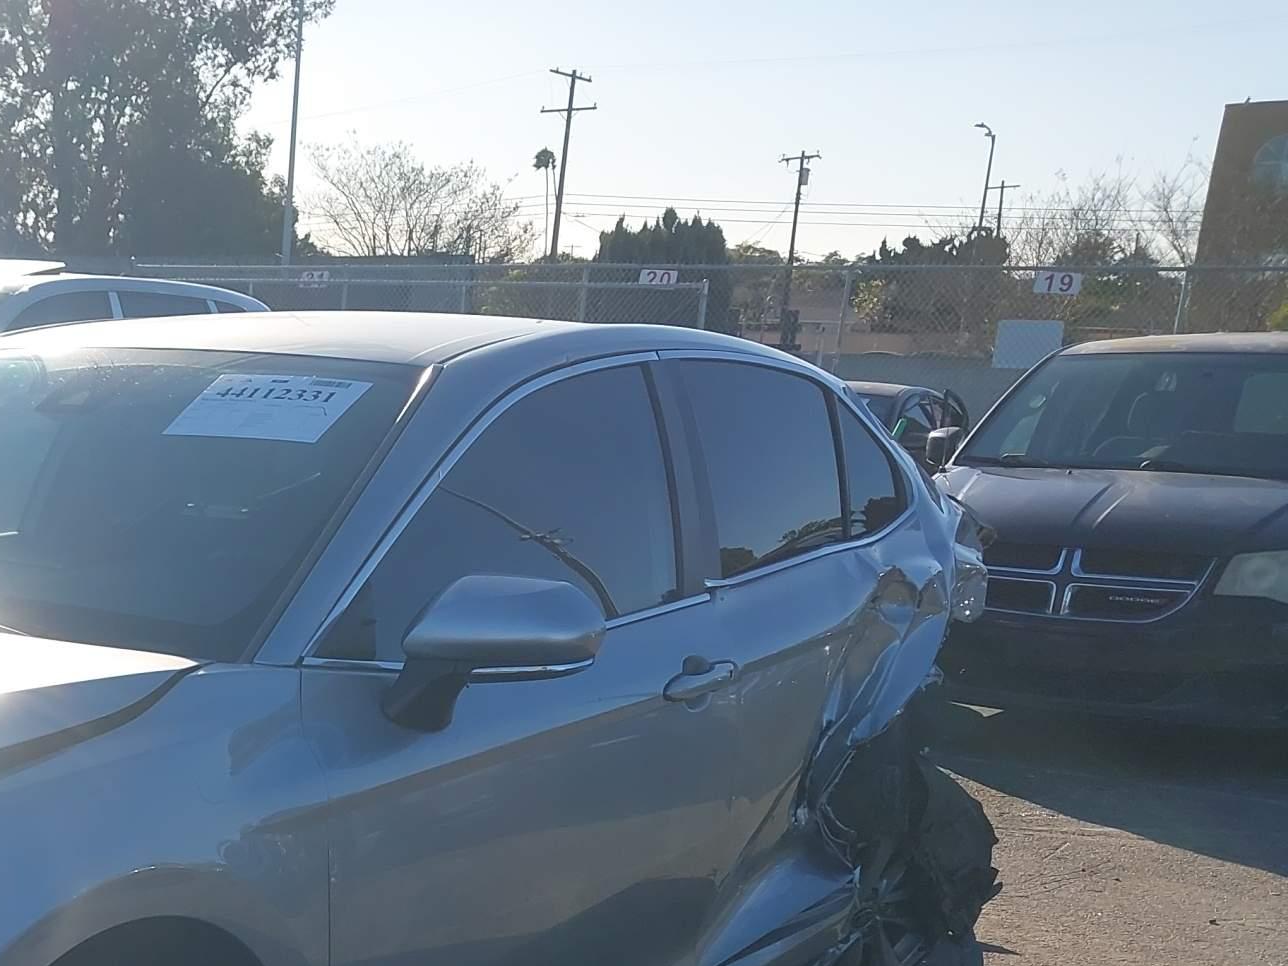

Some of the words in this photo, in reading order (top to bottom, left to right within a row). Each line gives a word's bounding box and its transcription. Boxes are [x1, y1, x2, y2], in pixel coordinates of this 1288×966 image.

[647, 270, 672, 285] 20
[1044, 273, 1074, 292] 19
[215, 386, 337, 403] 44112331
